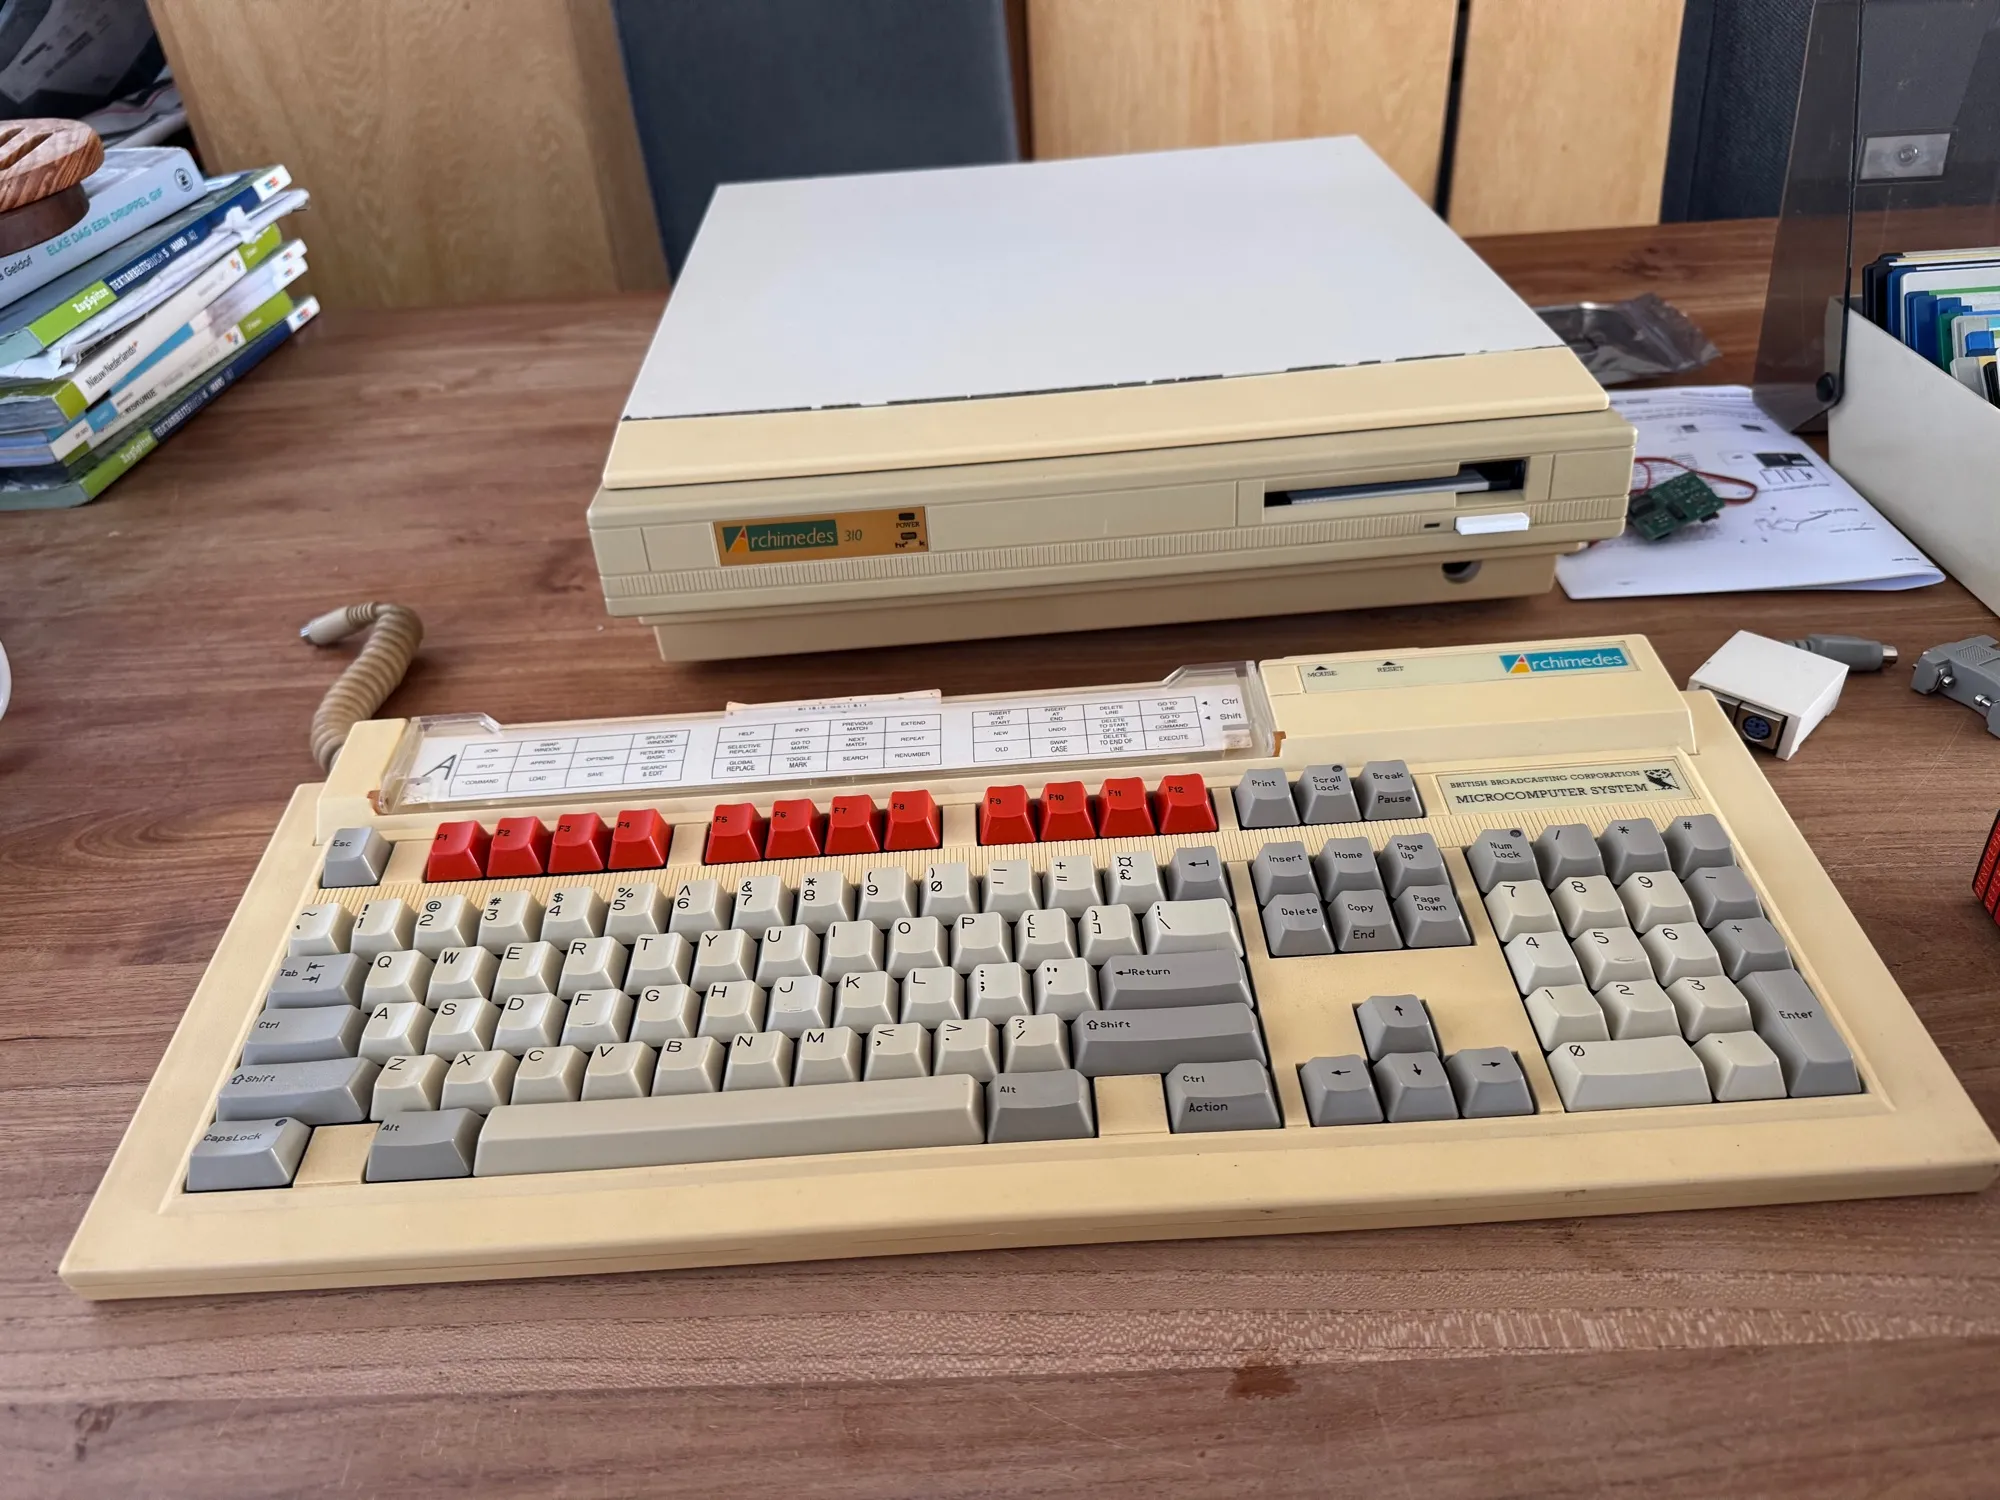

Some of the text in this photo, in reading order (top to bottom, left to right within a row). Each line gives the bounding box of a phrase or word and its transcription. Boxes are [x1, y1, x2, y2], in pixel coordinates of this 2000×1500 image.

[46, 237, 71, 256] ELKE
[71, 225, 92, 244] DAG
[92, 214, 111, 233] EEN
[110, 196, 150, 222] DRUPPEL
[895, 521, 921, 529] POWER
[727, 525, 863, 554] Archimedes 310
[1507, 653, 1622, 674] Archimedes
[1377, 665, 1404, 673] RESET
[1307, 670, 1337, 679] MOUSE
[1219, 713, 1242, 721] Shift
[1158, 734, 1189, 742] EXECUTE
[894, 751, 931, 759] RENUMBER
[422, 754, 457, 780] A
[726, 764, 756, 772] REPLACE
[1373, 772, 1404, 780] Break
[1450, 769, 1640, 789] BRITISH BROADCASTING CORPORATION
[1108, 789, 1122, 797] F11
[1168, 785, 1184, 794] F12
[1456, 782, 1649, 805] MICROCOMPUTER SYSTEM
[989, 797, 1002, 805] F9
[1049, 793, 1064, 801] F10
[1378, 795, 1412, 804] Pause
[557, 825, 571, 833] F3
[617, 821, 631, 829] F4
[436, 833, 448, 841] F1
[497, 829, 511, 837] F2
[332, 839, 352, 848] Esc
[1397, 843, 1424, 852] Page
[1490, 842, 1512, 850] Num
[1268, 854, 1303, 863] Insert
[1334, 851, 1363, 860] Home
[1400, 852, 1415, 860] Up
[1494, 851, 1521, 859] Lock
[1413, 894, 1441, 904] Page
[1281, 907, 1318, 916] Delete
[1347, 903, 1374, 913] Copy
[1417, 903, 1447, 912] Down
[897, 922, 911, 934] O
[962, 917, 975, 929] P
[832, 925, 837, 937] I
[1353, 930, 1375, 939] End
[705, 934, 718, 948] Y
[767, 930, 782, 943] U
[570, 942, 587, 955] R
[640, 938, 653, 951] T
[443, 951, 459, 965] W
[506, 946, 523, 960] E
[377, 955, 392, 969] Q
[280, 969, 298, 977] Tab
[1132, 968, 1171, 976] Return
[846, 976, 861, 989] K
[912, 971, 926, 985] L
[710, 985, 727, 998] H
[779, 981, 794, 993] J
[575, 993, 592, 1006] F
[645, 989, 660, 1002] G
[441, 1003, 457, 1016] S
[507, 998, 525, 1011] D
[374, 1007, 388, 1020] A
[1778, 1009, 1814, 1020] Enter
[258, 1021, 280, 1029] Ctrl
[1100, 1020, 1130, 1028] Shift
[736, 1036, 753, 1047] N
[806, 1031, 825, 1043] M
[599, 1045, 615, 1058] V
[666, 1040, 683, 1053] B
[456, 1053, 476, 1066] X
[528, 1050, 545, 1062] C
[388, 1058, 407, 1071] Z
[244, 1074, 275, 1083] Shift
[1182, 1075, 1205, 1083] Ctrl
[1000, 1085, 1017, 1093] Alt
[1188, 1102, 1228, 1113] Action
[381, 1123, 400, 1132] Alt
[203, 1132, 262, 1143] CapsLock
